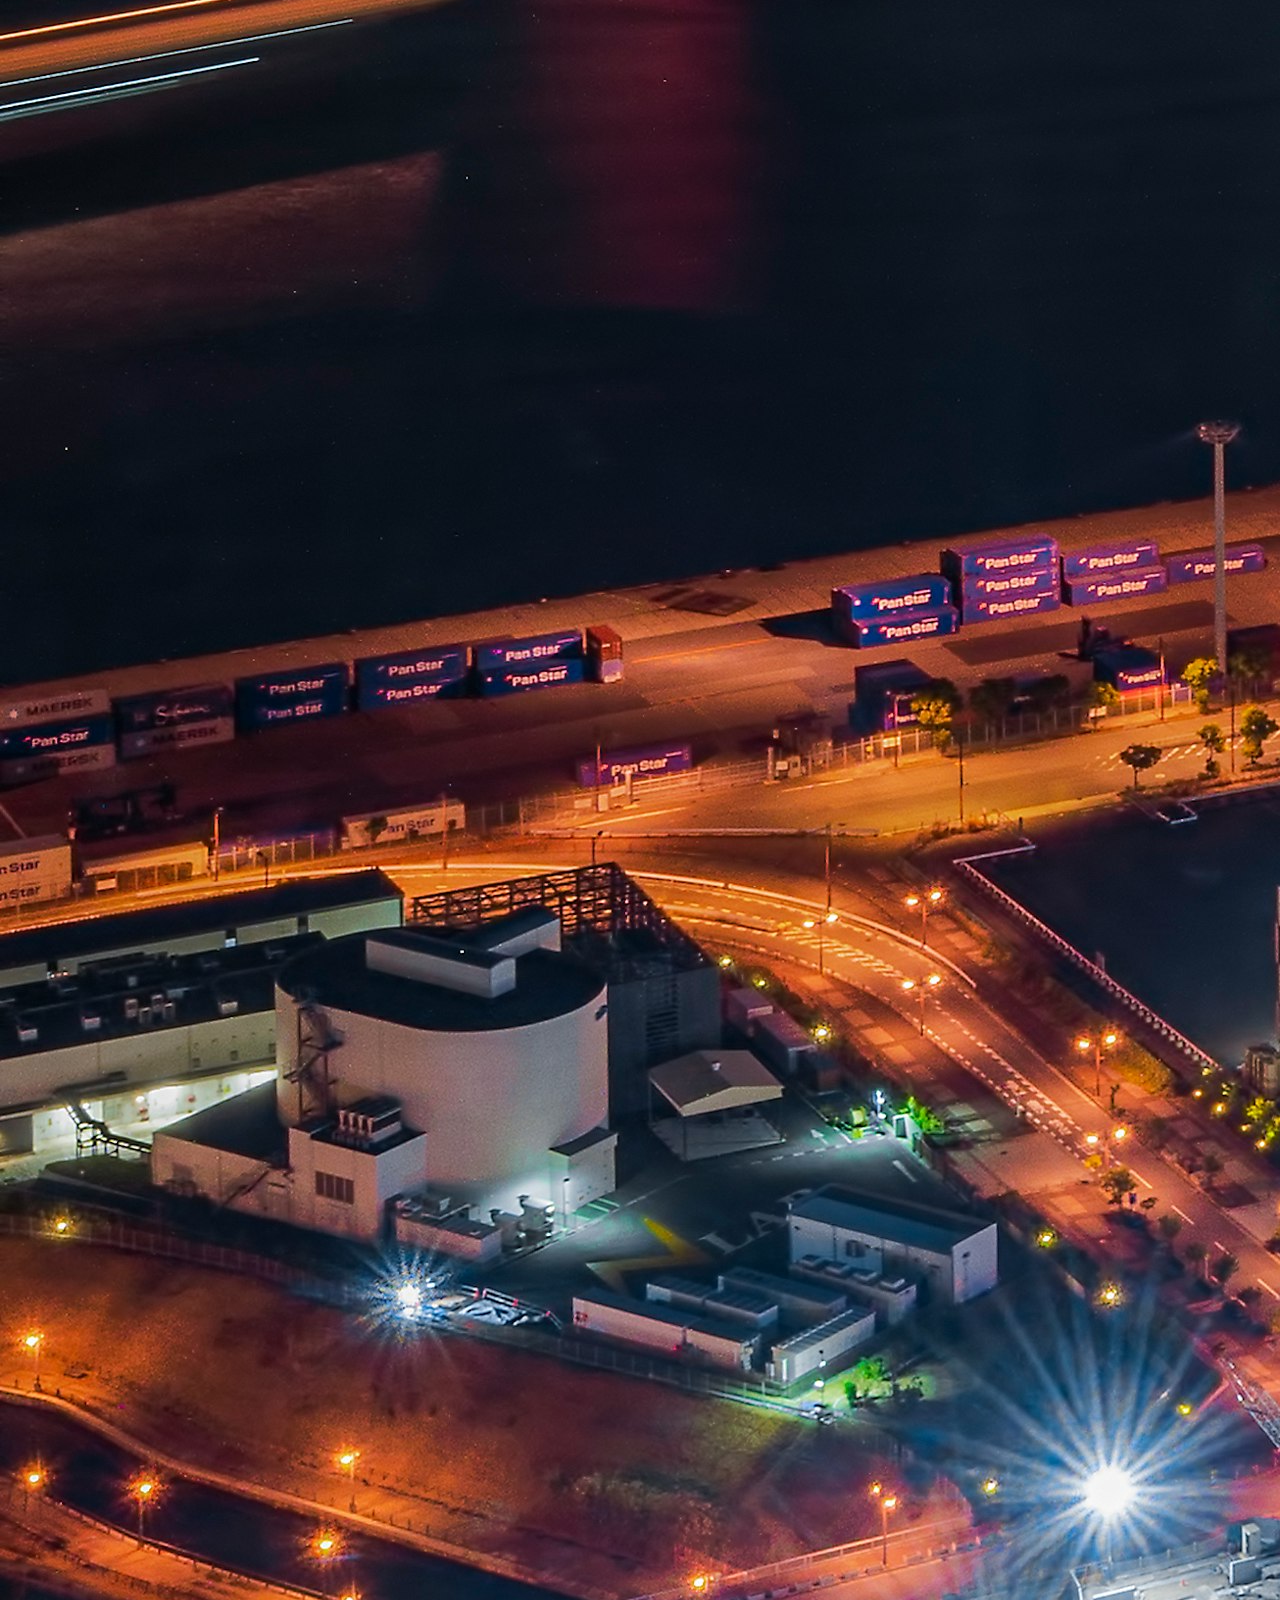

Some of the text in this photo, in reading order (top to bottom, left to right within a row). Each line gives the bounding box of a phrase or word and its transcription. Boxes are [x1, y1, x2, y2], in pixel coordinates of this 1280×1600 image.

[985, 553, 1037, 569] Pan Star
[1089, 552, 1140, 569] Pan Star
[986, 575, 1037, 592] Pan Star
[1097, 580, 1148, 597] Pan Star
[878, 593, 931, 611] Pan Star
[988, 597, 1041, 615] Pan Star
[886, 621, 939, 639] Pan Star
[505, 644, 561, 662] Pan Star
[389, 659, 444, 677] Pan Star
[512, 668, 567, 687] Pan Star
[269, 678, 325, 696] Pan Star
[386, 683, 442, 701] Pan Star
[25, 697, 93, 717] MAERSK
[31, 729, 90, 749] Pan Star
